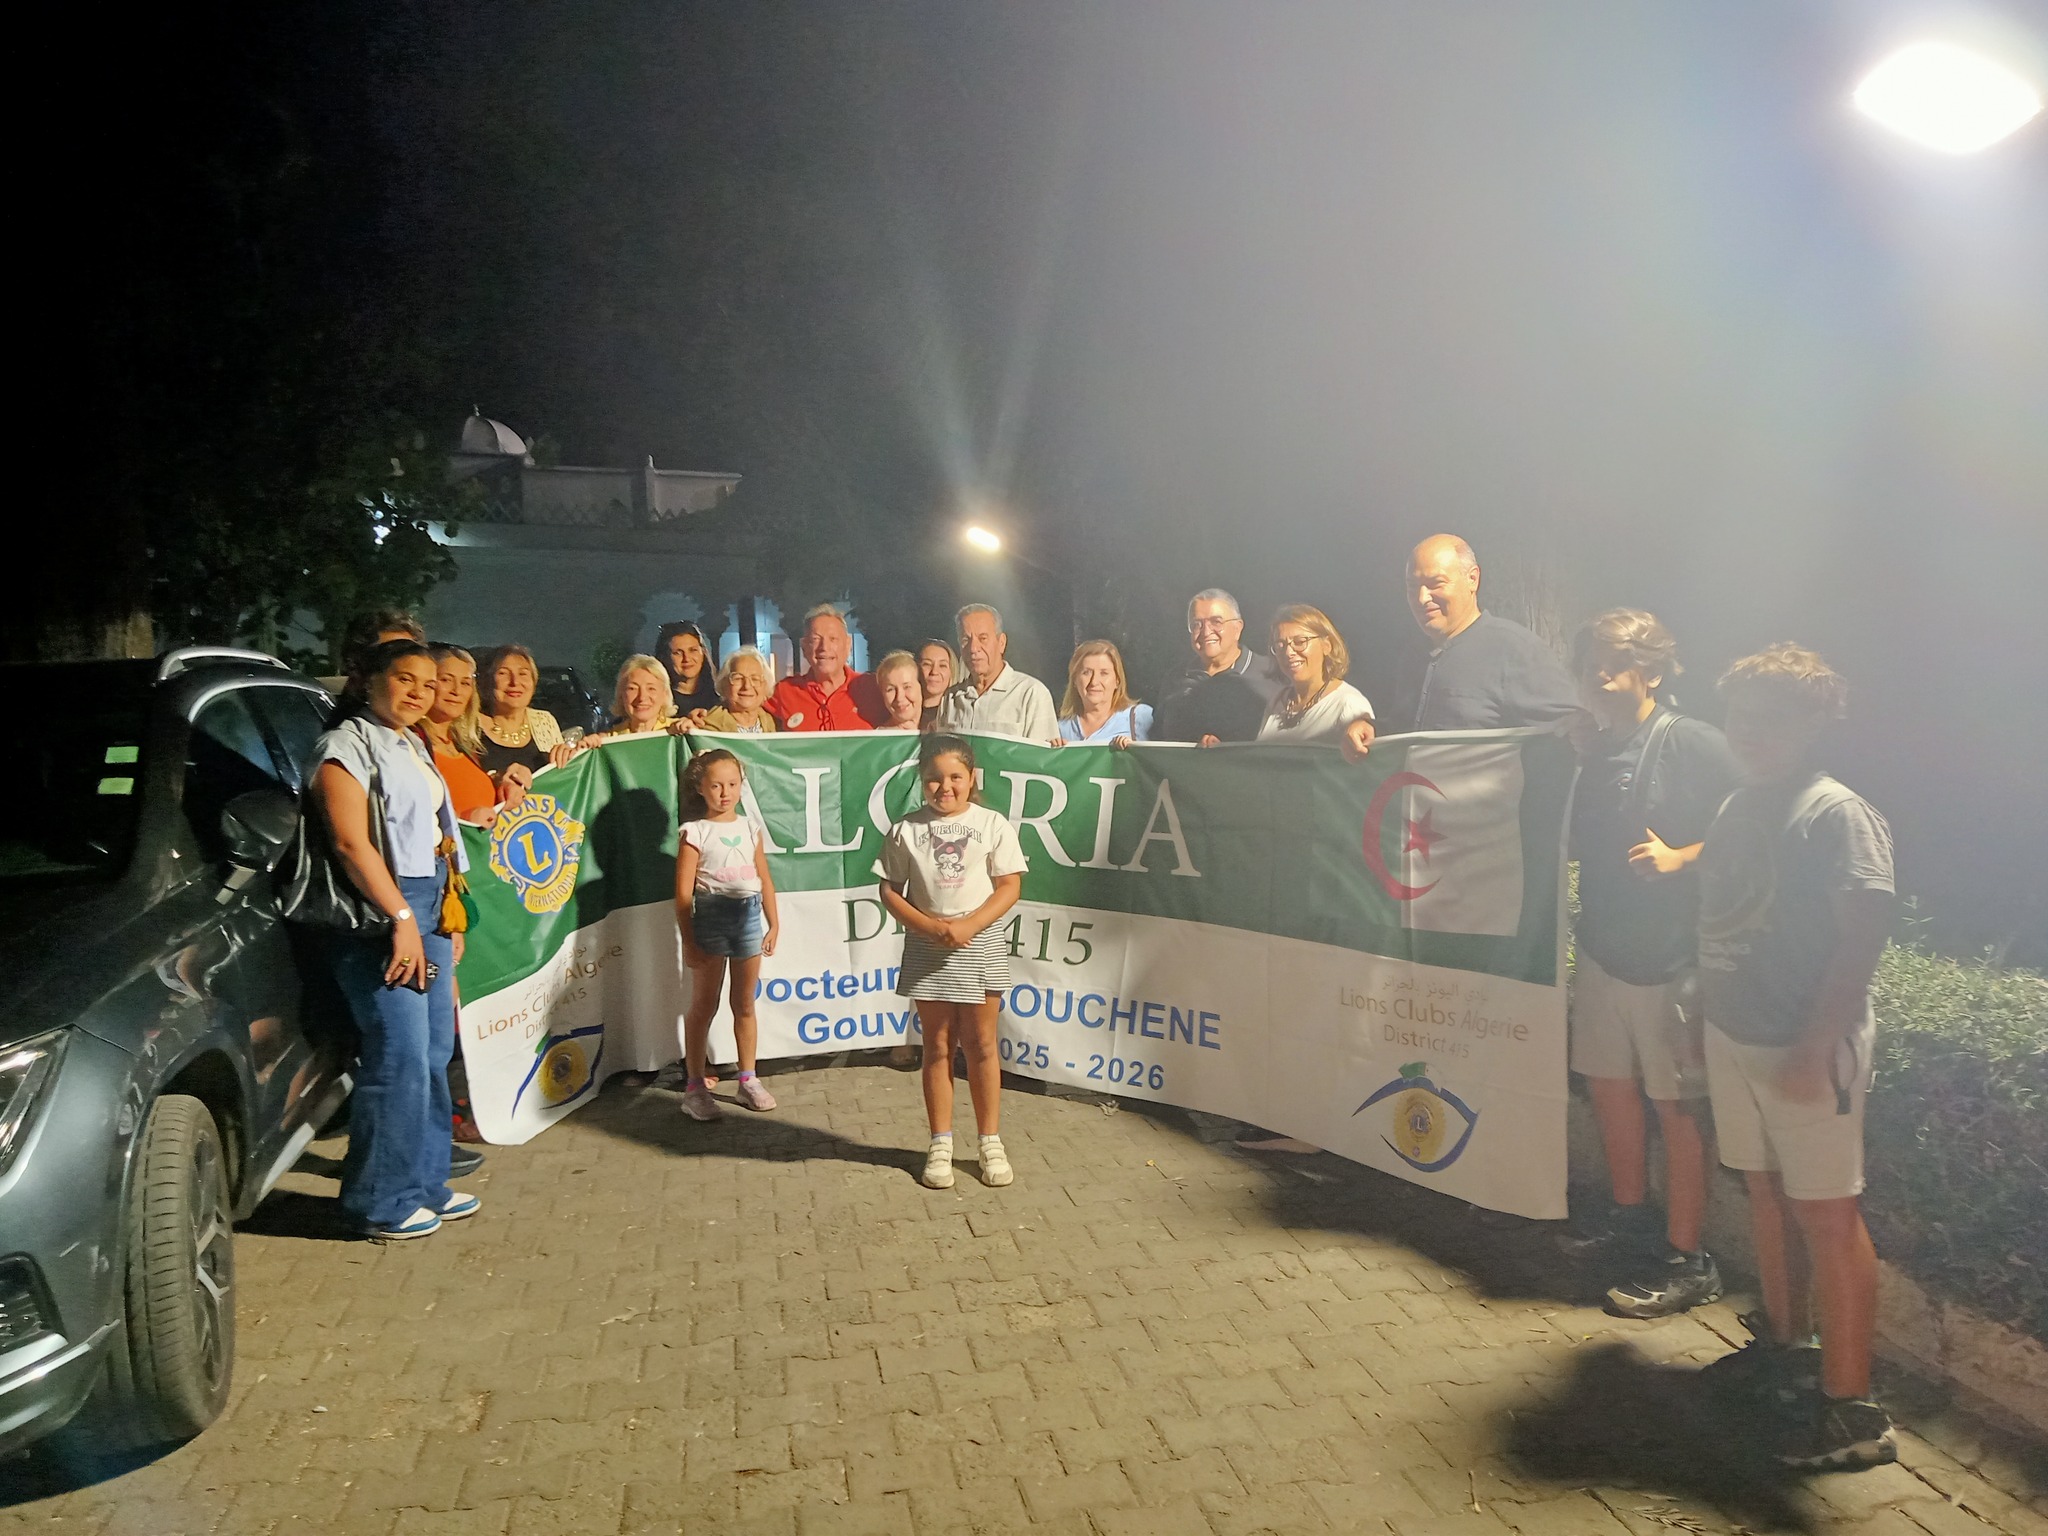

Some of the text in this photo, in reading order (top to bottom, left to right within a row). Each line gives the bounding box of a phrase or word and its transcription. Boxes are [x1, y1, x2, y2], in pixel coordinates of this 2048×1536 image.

[517, 832, 552, 875] L
[919, 823, 982, 847] KUROMI
[1003, 914, 1094, 966] 415
[477, 1008, 529, 1041] Lions
[1340, 987, 1388, 1015] Lions
[1394, 998, 1456, 1027] Clubs
[1384, 1024, 1446, 1053] District
[1000, 1038, 1050, 1069] 025
[1087, 1054, 1164, 1090] 2026
